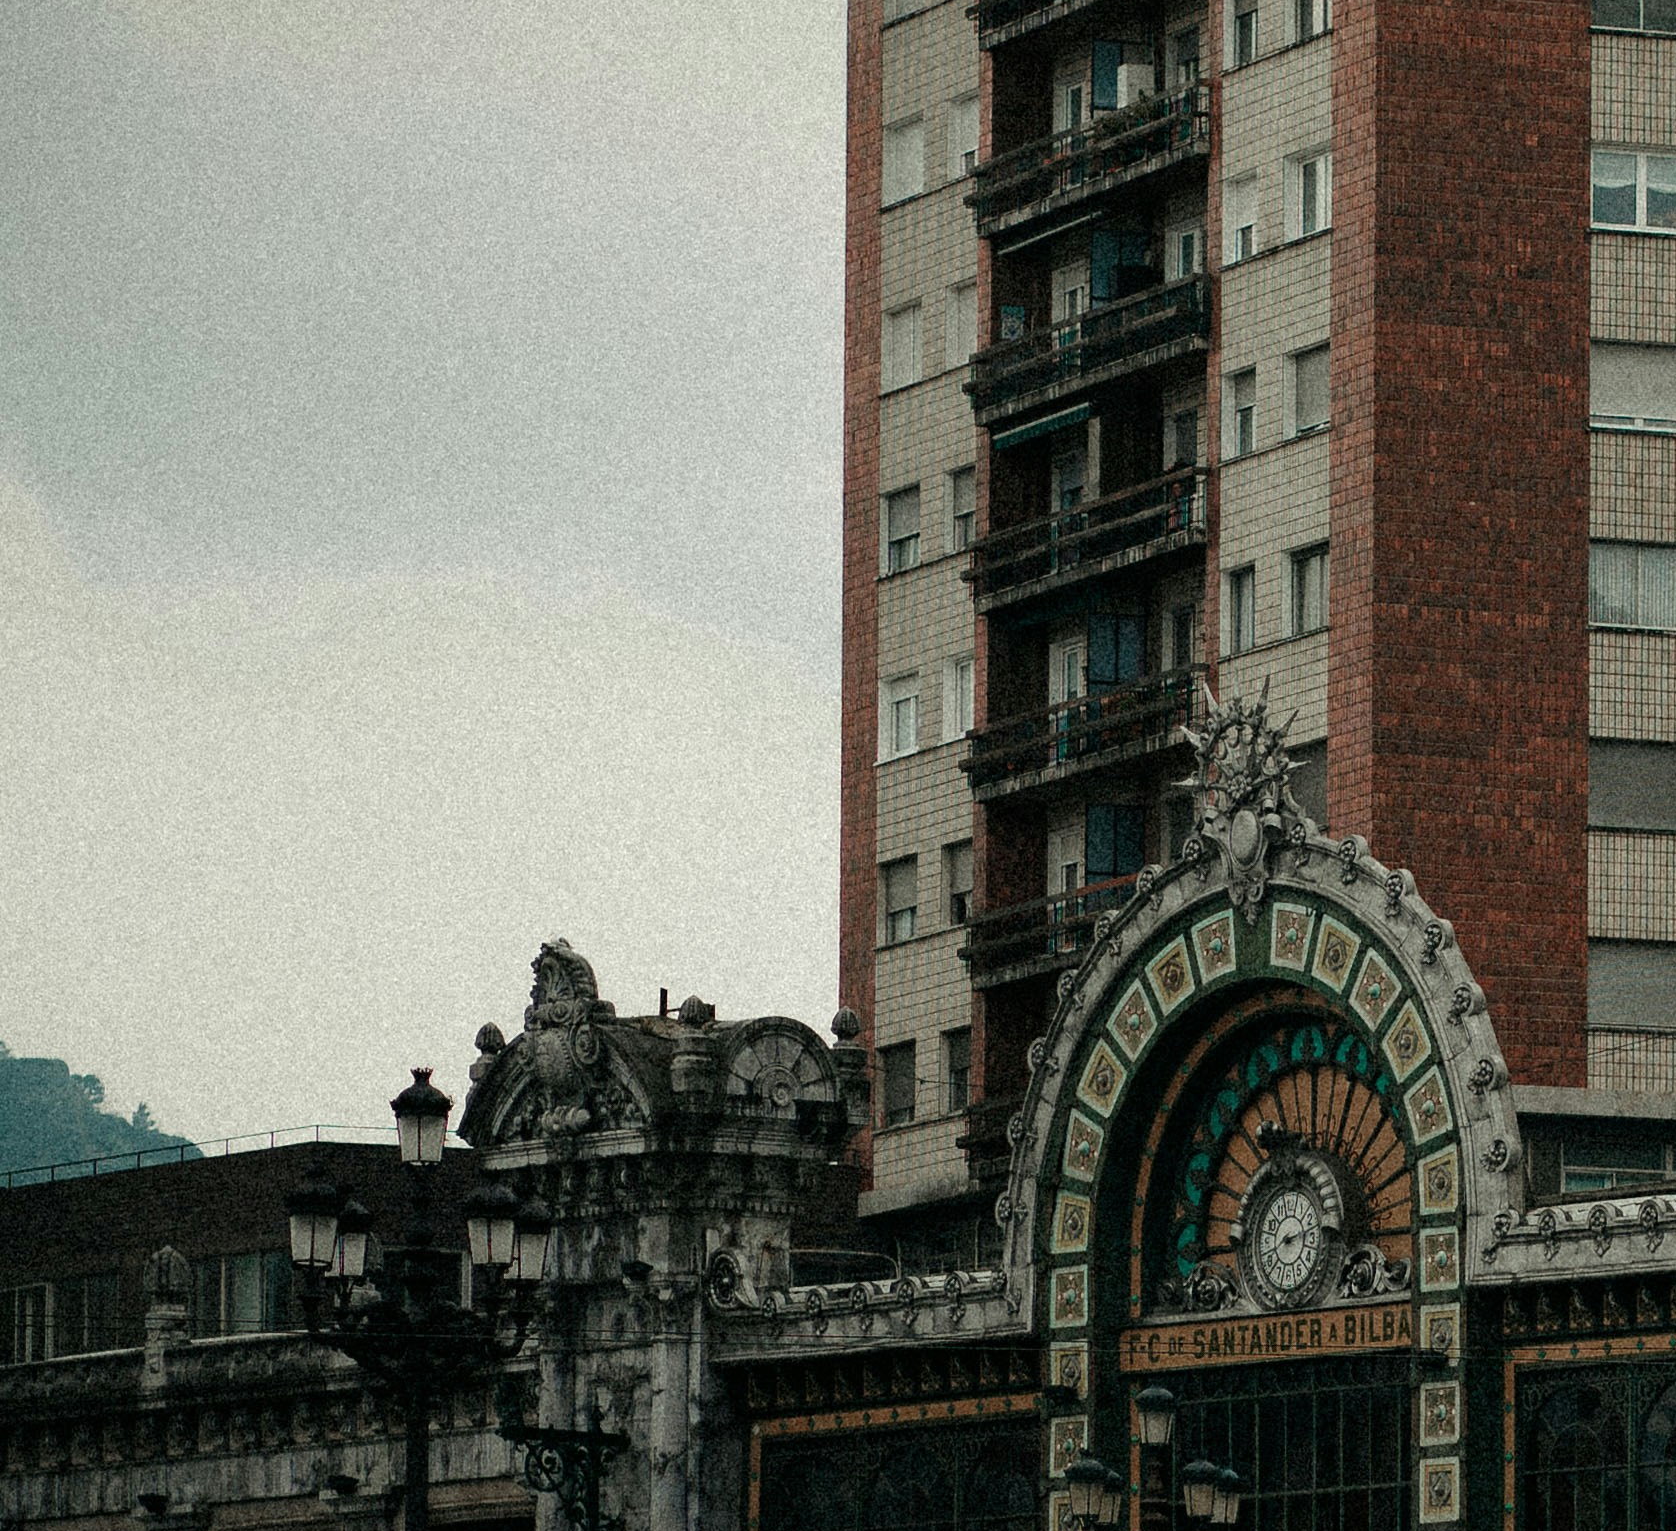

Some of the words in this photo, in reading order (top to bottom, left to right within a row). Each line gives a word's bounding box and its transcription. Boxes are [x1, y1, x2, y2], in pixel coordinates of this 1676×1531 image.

[1192, 1318, 1323, 1359] SANTANDER
[1329, 1322, 1338, 1343] A
[1344, 1309, 1411, 1346] BILBA
